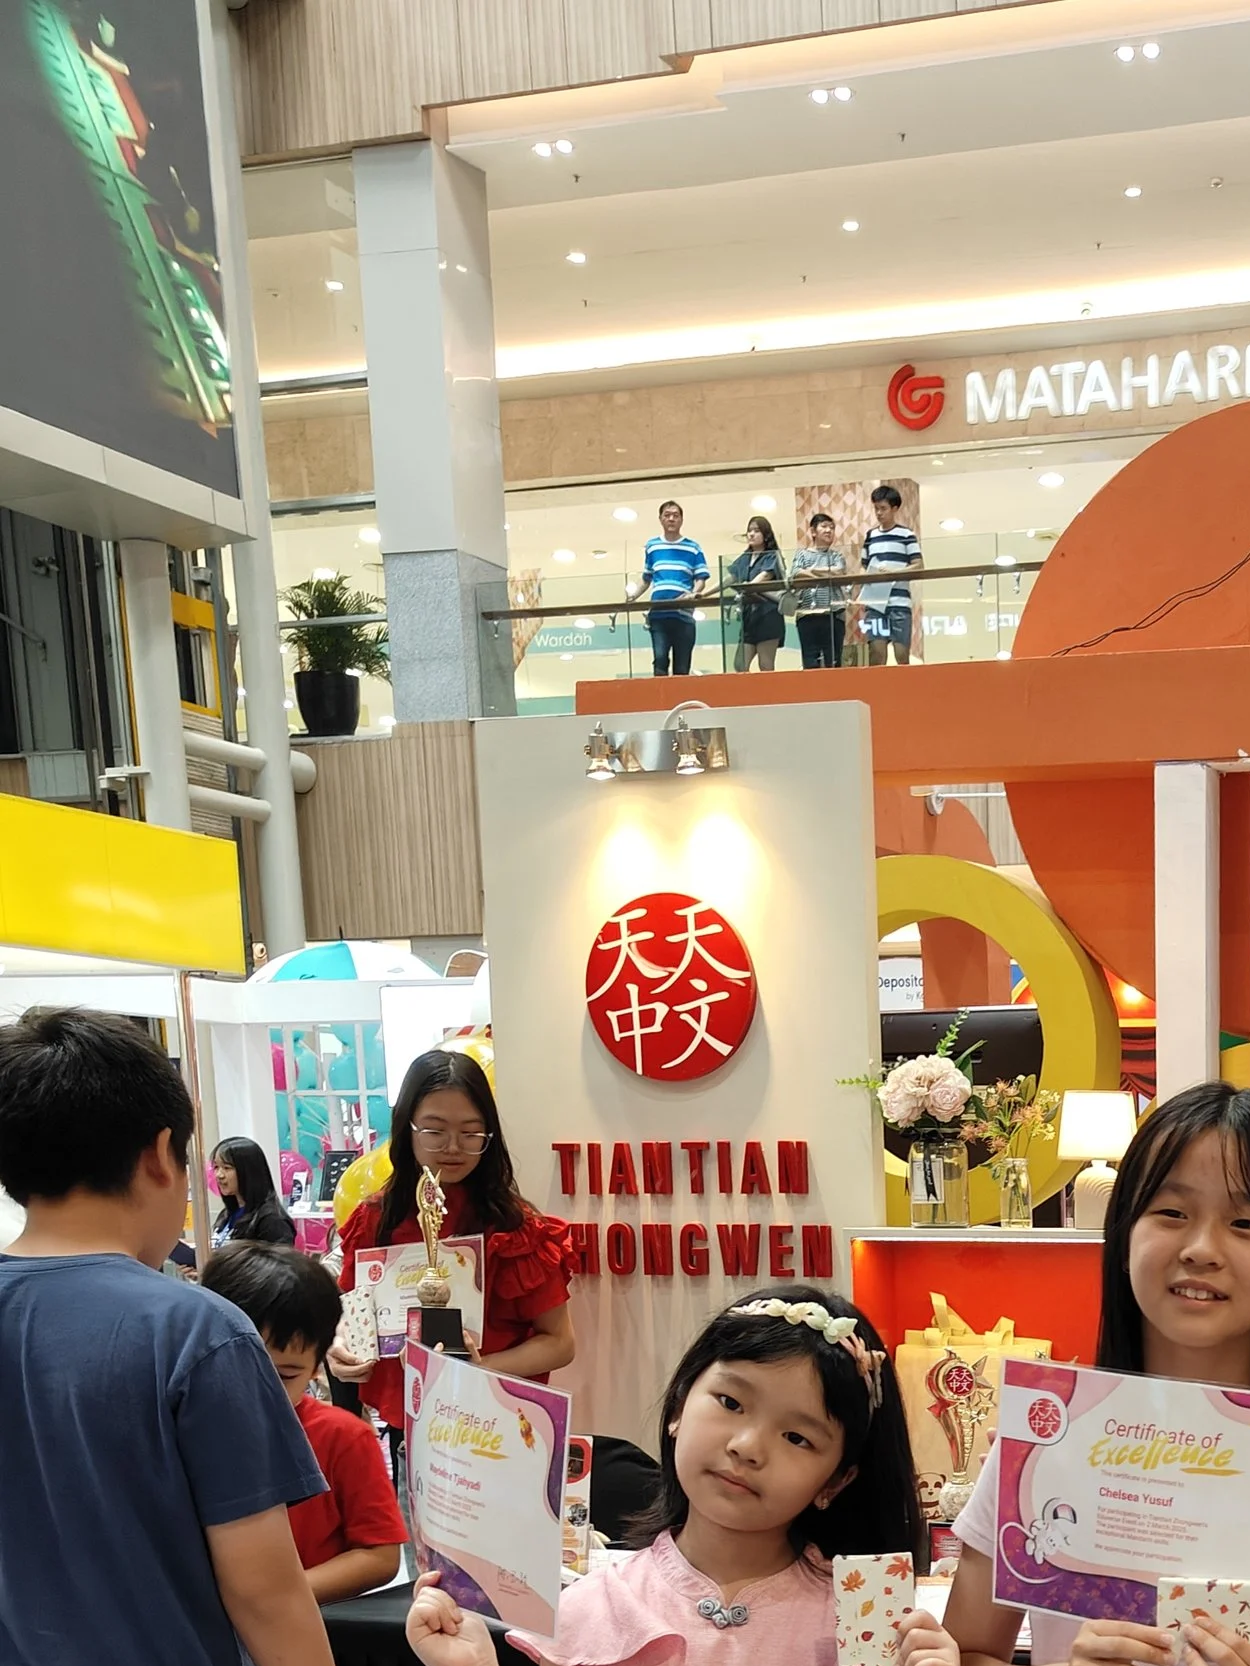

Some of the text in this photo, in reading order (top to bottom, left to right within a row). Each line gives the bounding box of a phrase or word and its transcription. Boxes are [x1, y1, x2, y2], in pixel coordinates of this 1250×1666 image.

[534, 632, 592, 648] Wardah
[587, 901, 751, 1001] 天天
[605, 979, 733, 1075] 中文
[551, 1141, 809, 1195] TIANTIAN
[570, 1222, 833, 1277] HONGWEN
[435, 1398, 498, 1432] Certificate of
[1028, 1400, 1061, 1420] 天天
[1030, 1415, 1057, 1436] 中文
[1104, 1418, 1224, 1450] Certificate of
[1087, 1436, 1236, 1470] Excellence
[1099, 1486, 1174, 1507] Chelsea Yusuf
